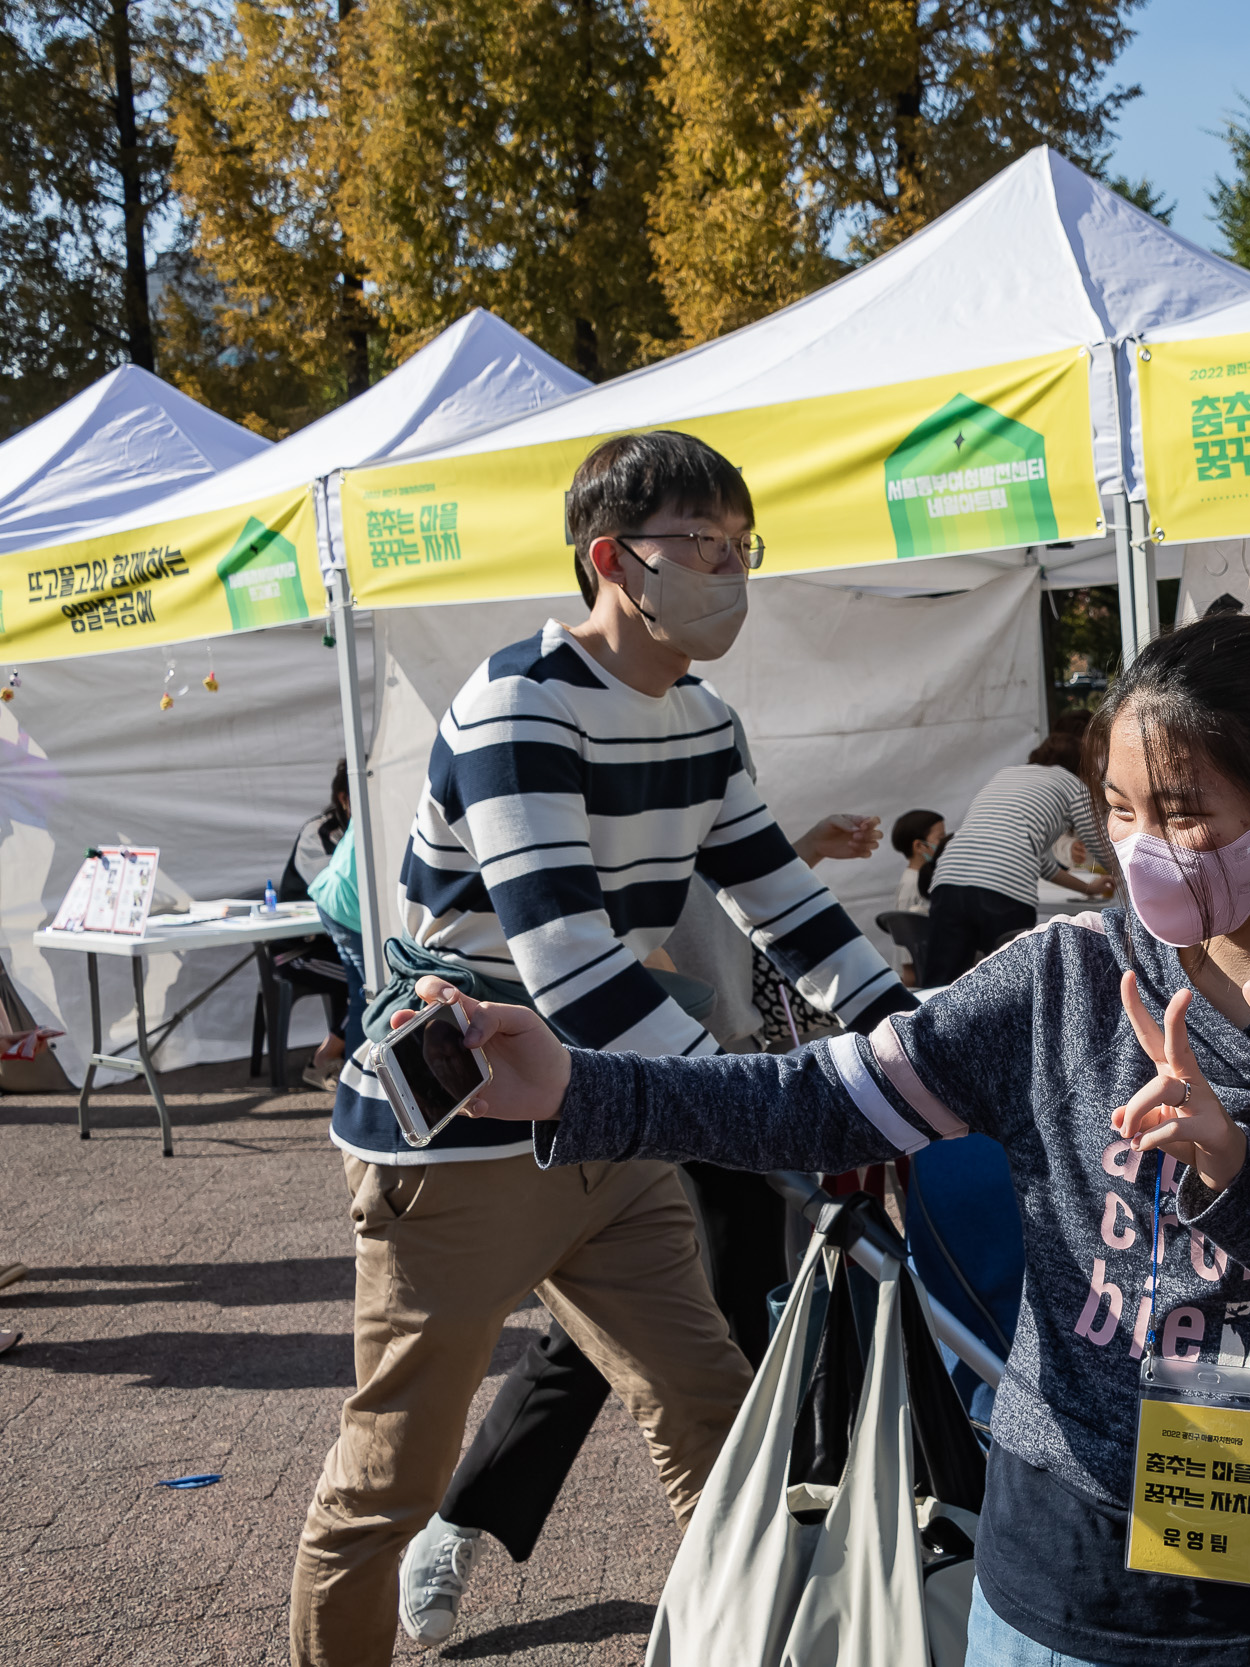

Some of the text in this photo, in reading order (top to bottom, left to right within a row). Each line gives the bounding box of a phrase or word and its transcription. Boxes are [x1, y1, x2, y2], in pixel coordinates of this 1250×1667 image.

[1189, 366, 1224, 381] 2022
[366, 501, 458, 539] 춤추는 마을
[369, 531, 461, 568] 꿈꾸는 자치
[110, 545, 190, 589] 함께하는
[61, 590, 156, 633] 양말목공예
[1161, 1429, 1181, 1439] 2022
[1181, 1431, 1201, 1441] 광진구
[1145, 1452, 1206, 1478] 춤추는
[1144, 1482, 1205, 1509] 꿈꾸는
